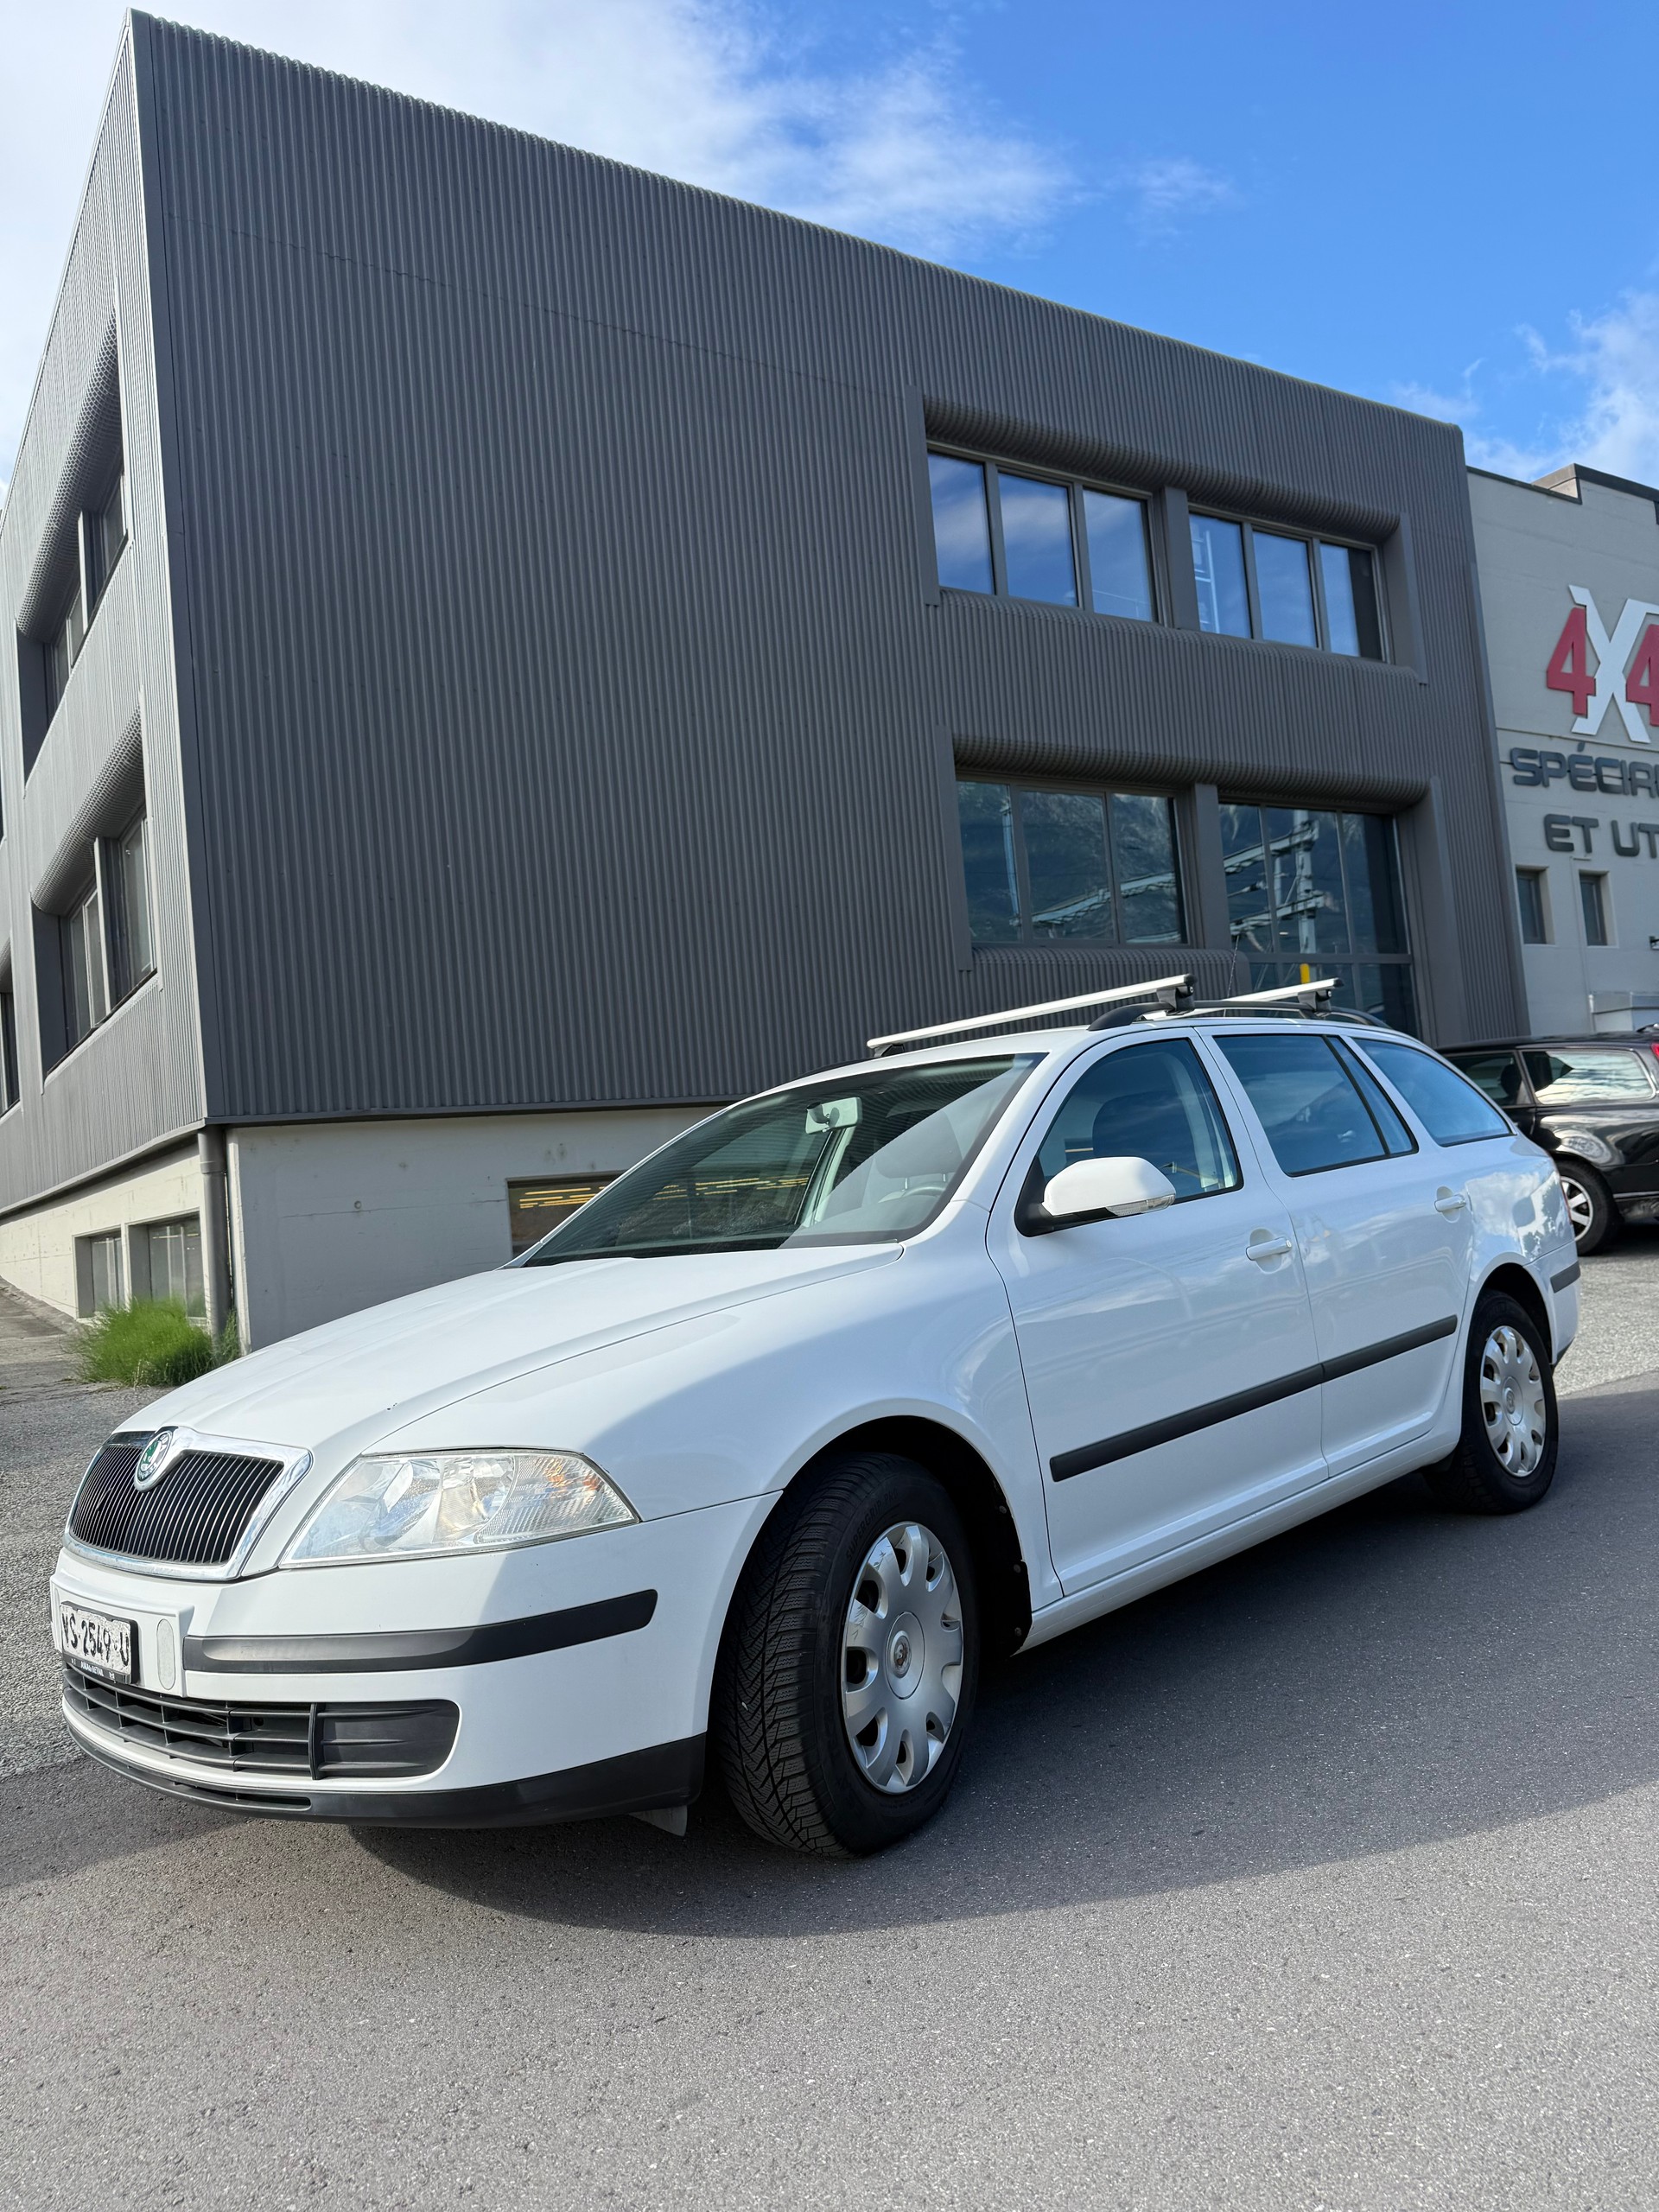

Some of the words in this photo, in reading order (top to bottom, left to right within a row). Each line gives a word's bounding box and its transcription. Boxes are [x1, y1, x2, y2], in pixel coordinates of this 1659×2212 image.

[1510, 741, 1659, 798] SPÉCIA
[1544, 813, 1599, 854] ET
[847, 1499, 881, 1561] SUPERGRIP
